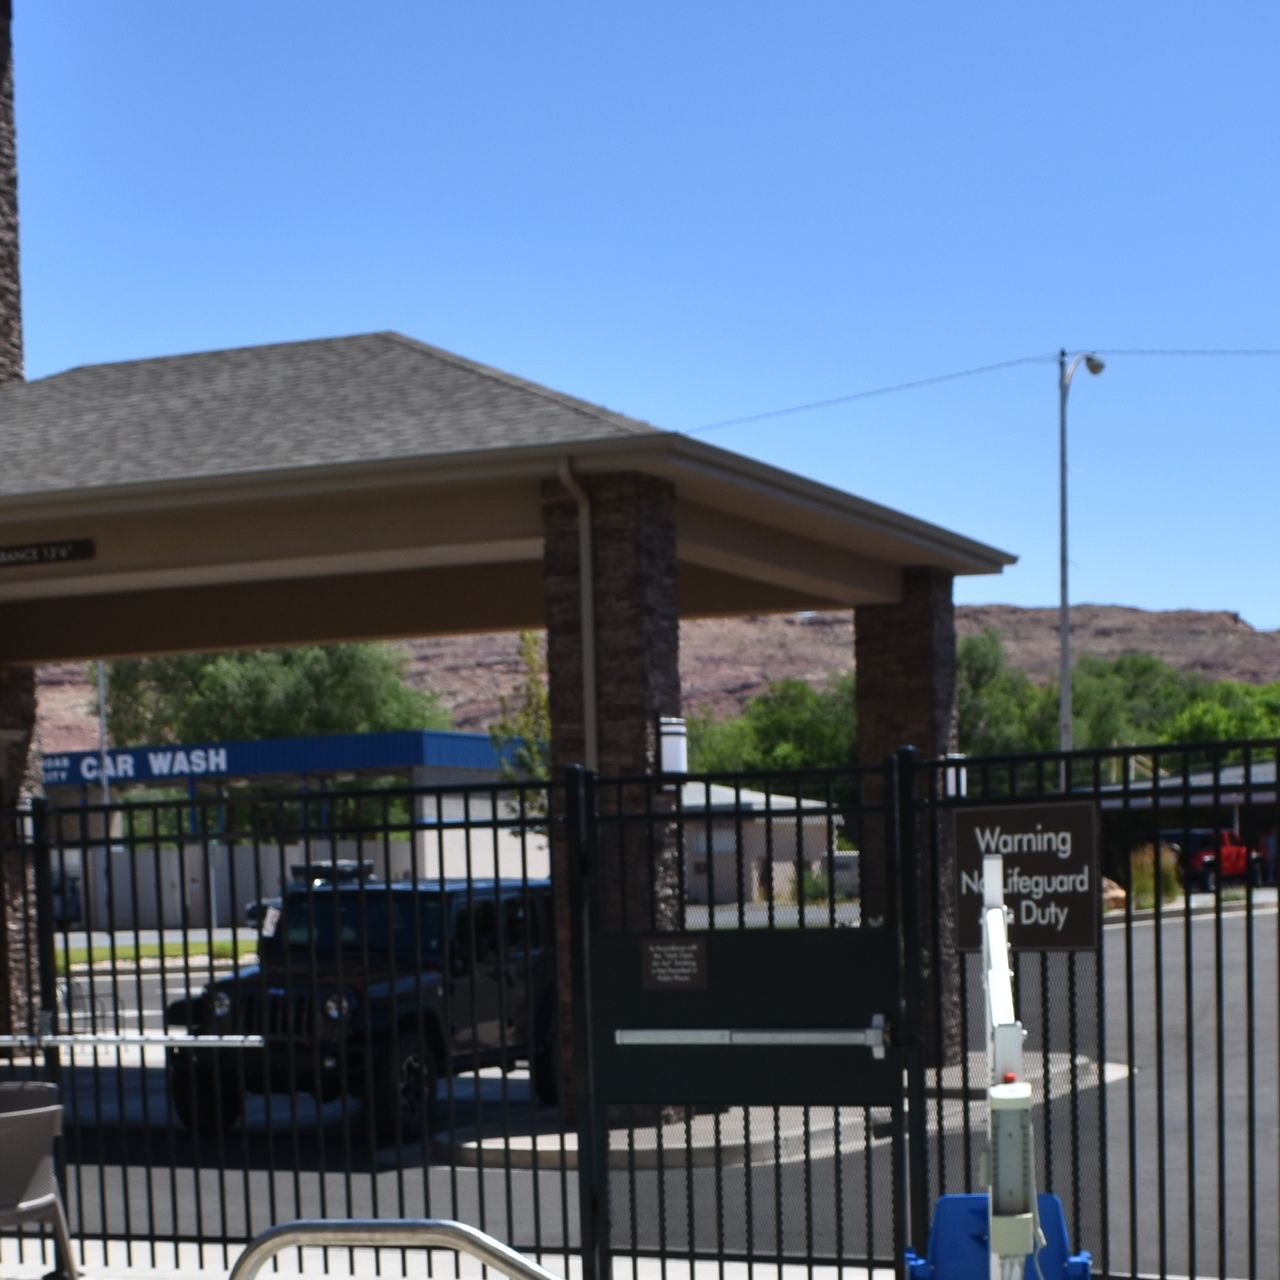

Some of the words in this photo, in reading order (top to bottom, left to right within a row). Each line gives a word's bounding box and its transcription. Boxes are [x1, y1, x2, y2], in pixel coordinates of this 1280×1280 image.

[80, 754, 135, 781] CAR
[147, 747, 228, 776] WASH
[974, 823, 1072, 859] Warning
[1020, 899, 1070, 932] Duty
